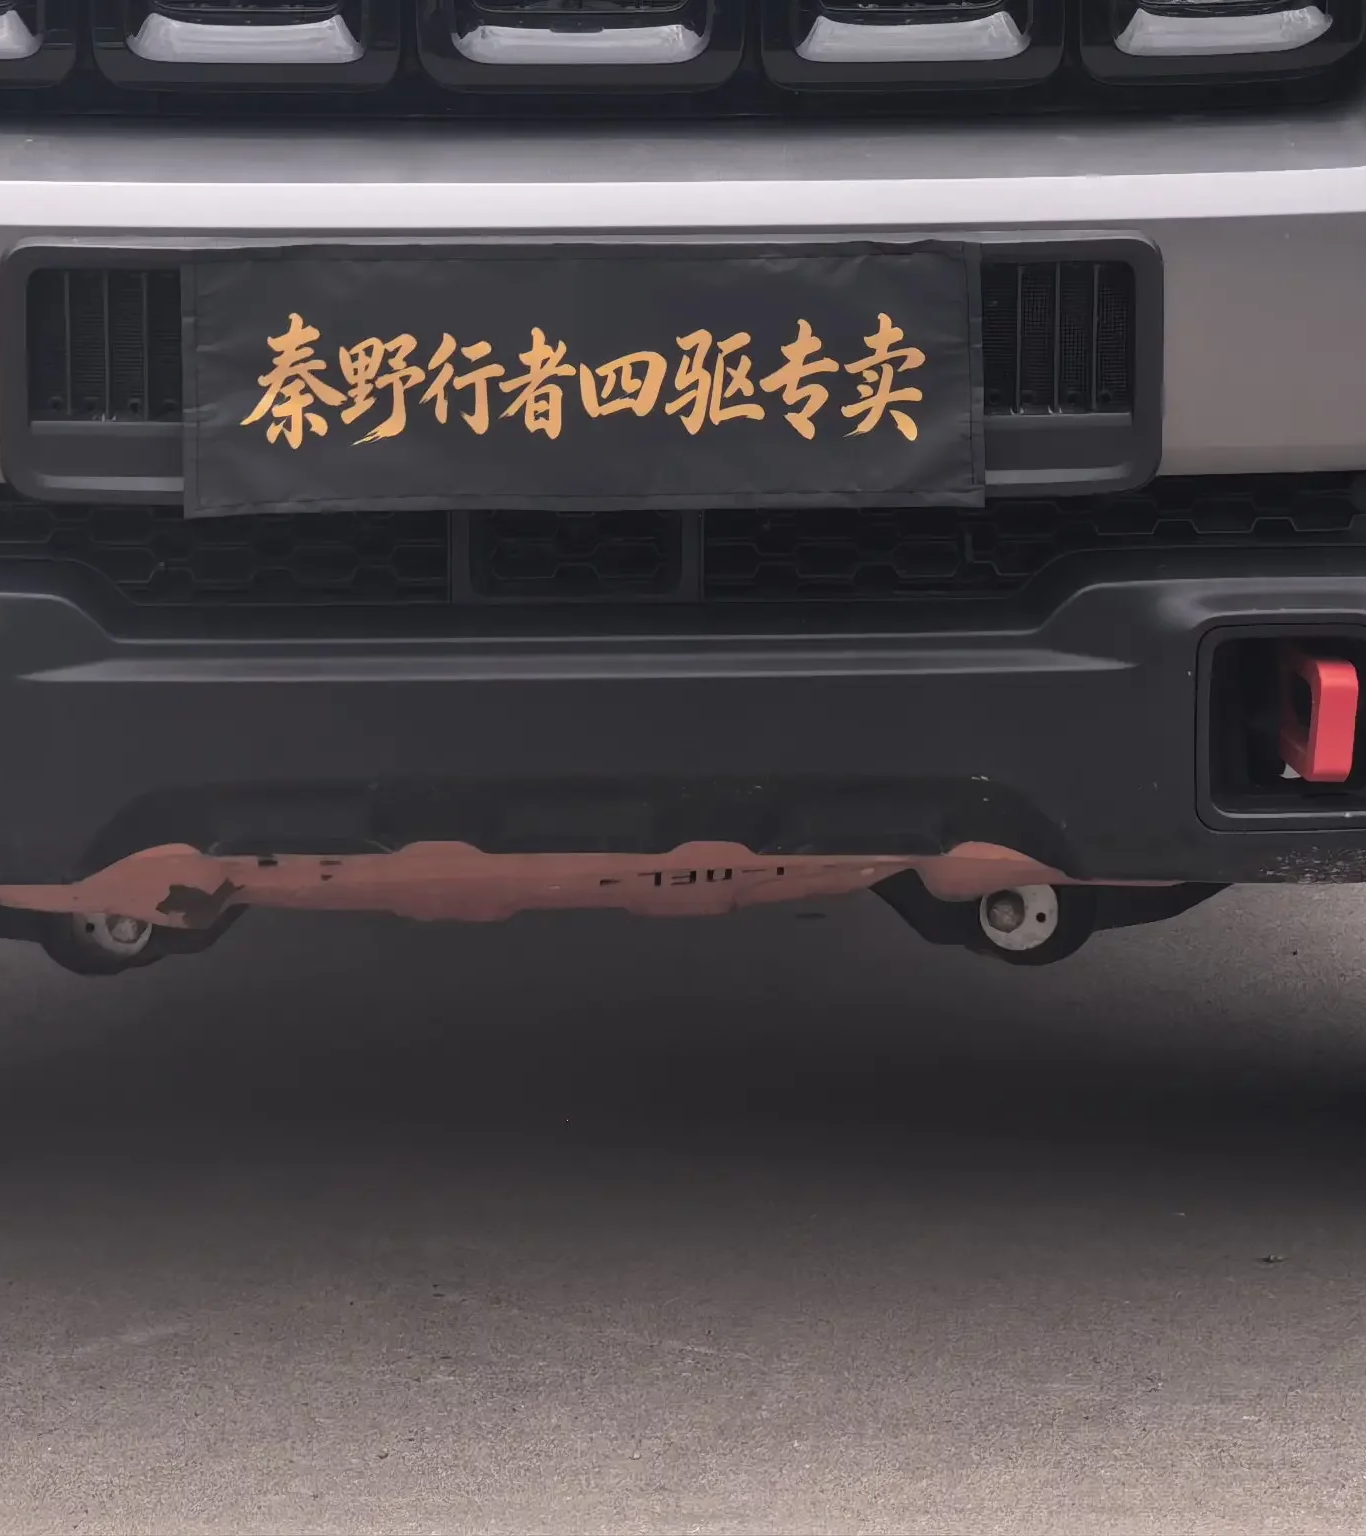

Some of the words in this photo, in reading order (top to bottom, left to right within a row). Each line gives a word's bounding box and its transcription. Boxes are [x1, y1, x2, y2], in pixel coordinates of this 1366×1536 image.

[240, 312, 927, 449] 秦野行者四驱专卖
